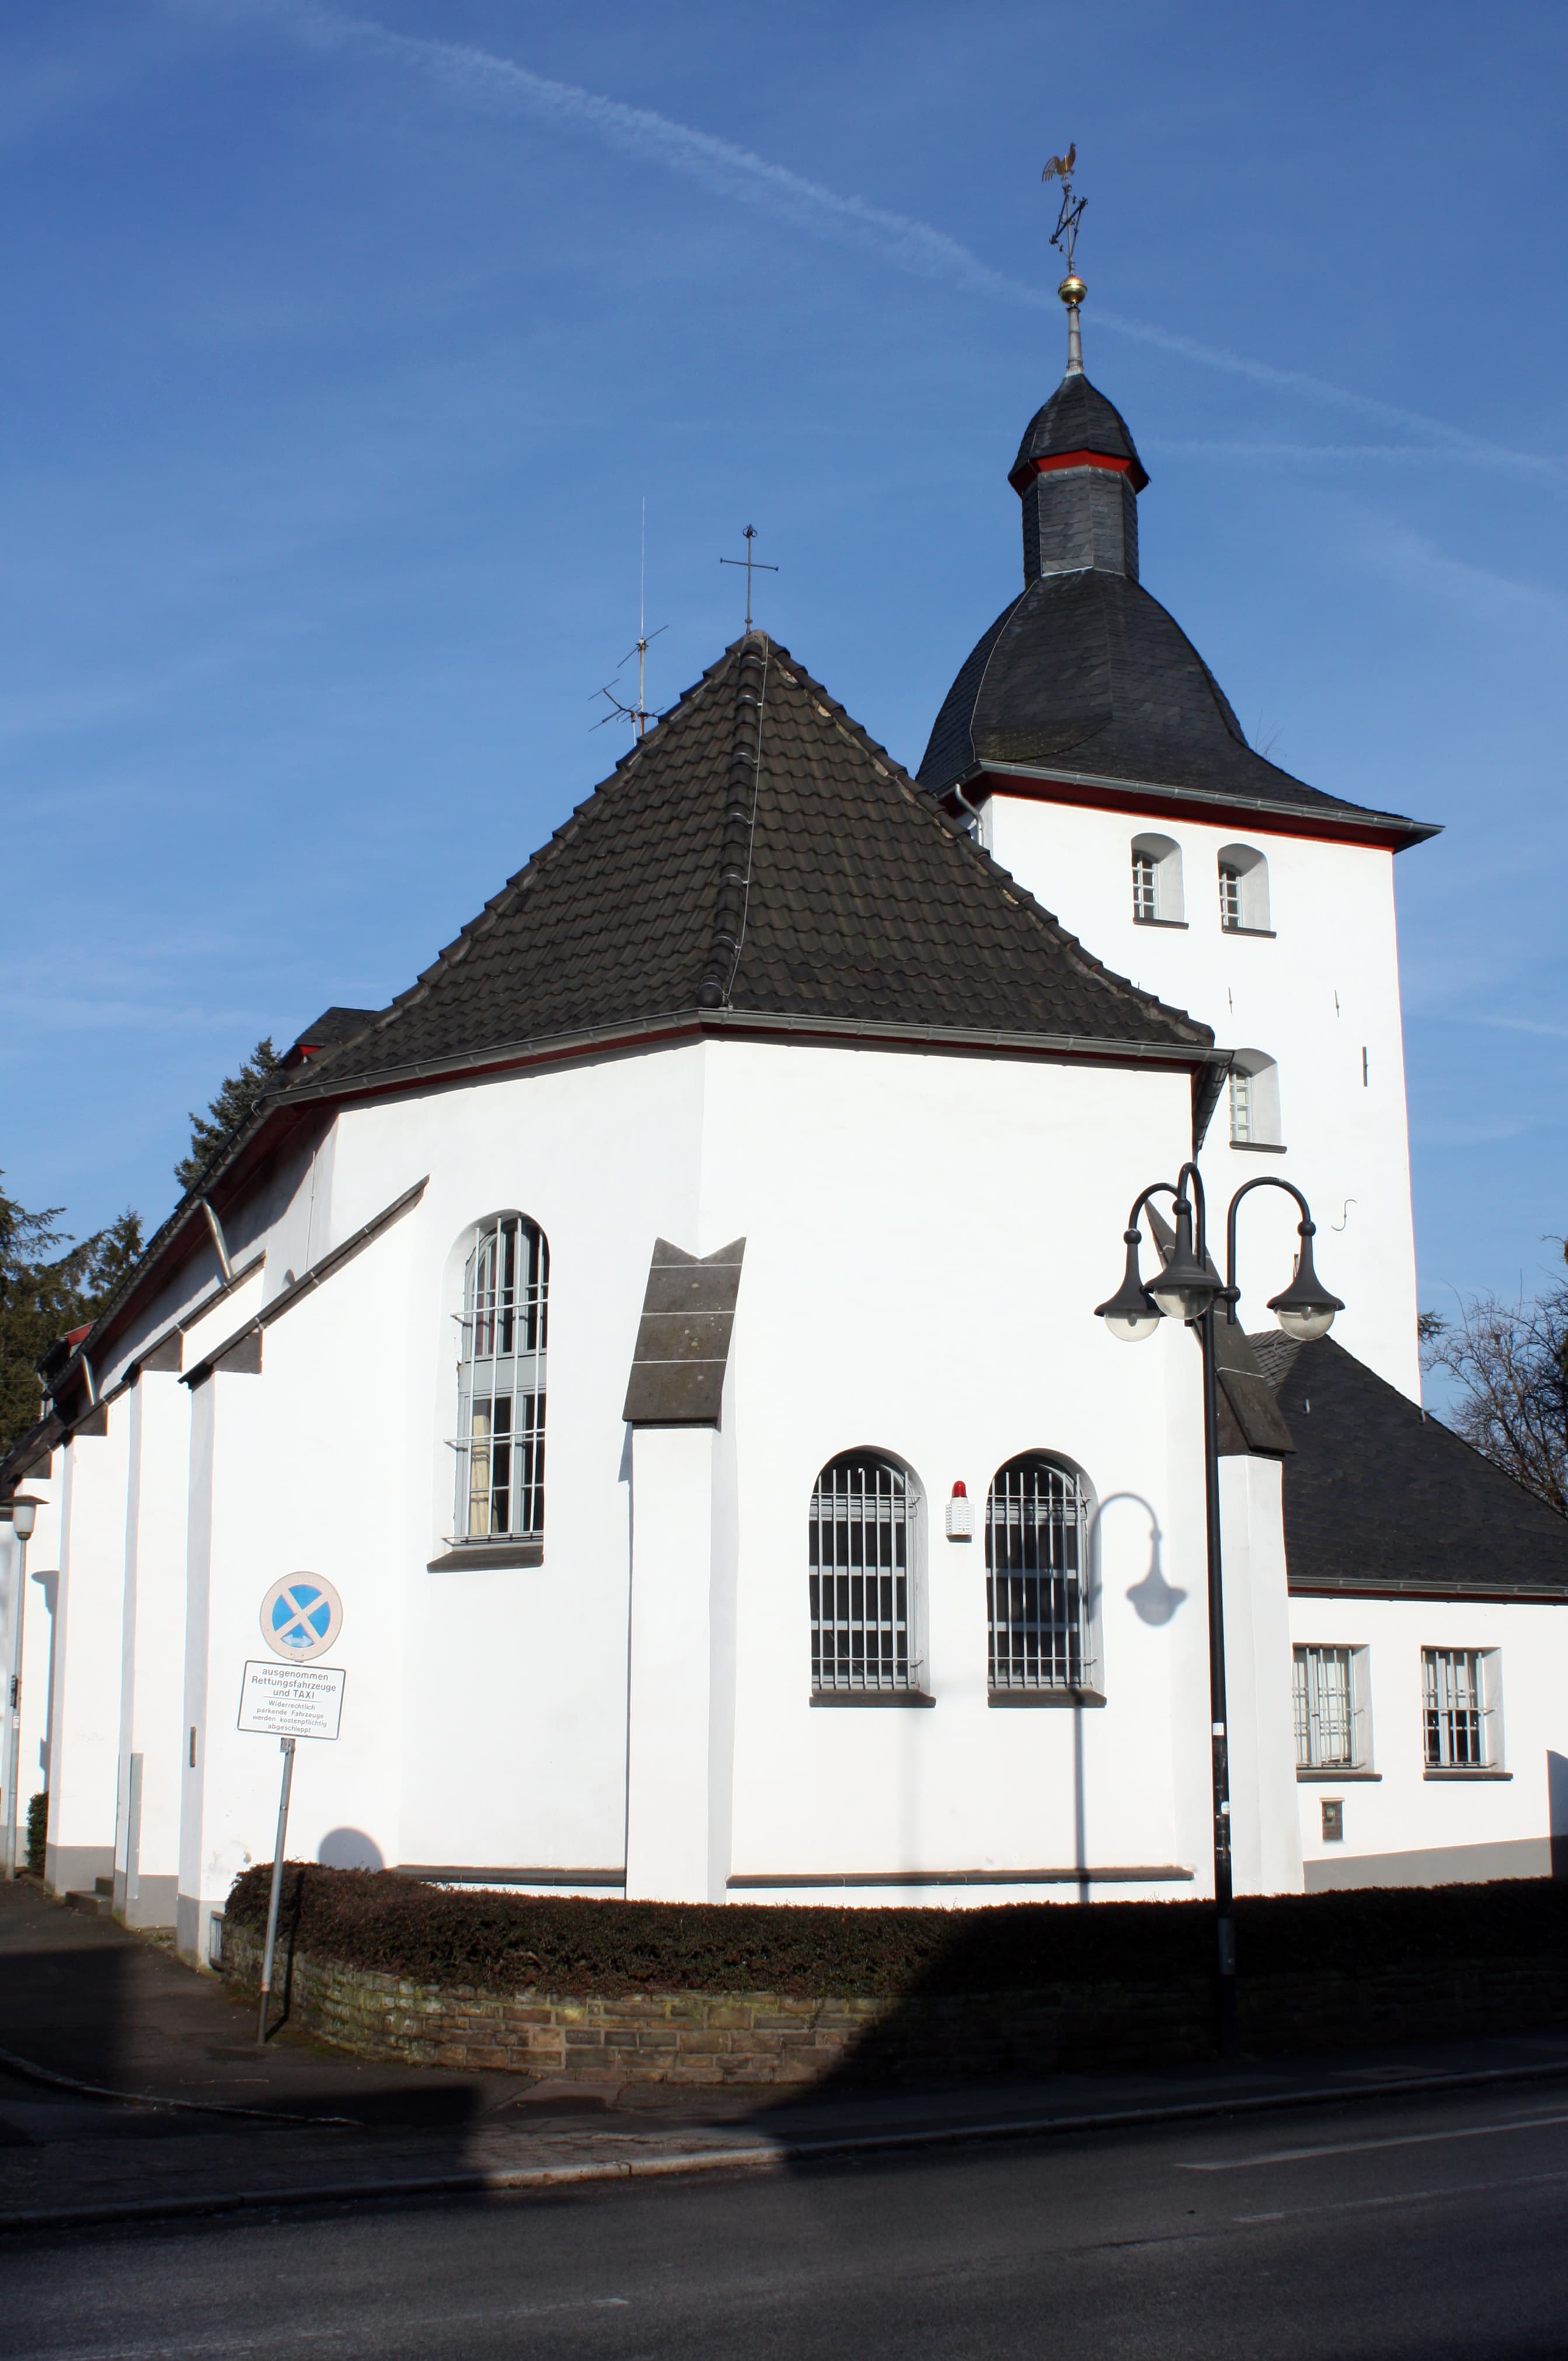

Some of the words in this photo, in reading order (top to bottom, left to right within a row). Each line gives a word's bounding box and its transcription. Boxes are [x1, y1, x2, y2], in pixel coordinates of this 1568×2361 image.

[262, 1668, 329, 1680] ausgenommen
[252, 1676, 336, 1692] Rettungsfahrzeuge
[293, 1690, 315, 1699] TAXI
[269, 1700, 315, 1710] Widerrechtlich
[291, 1710, 324, 1719] Fahrzeuge
[280, 1717, 327, 1728] kostenpflichtig
[267, 1724, 311, 1734] abgeschleppt
